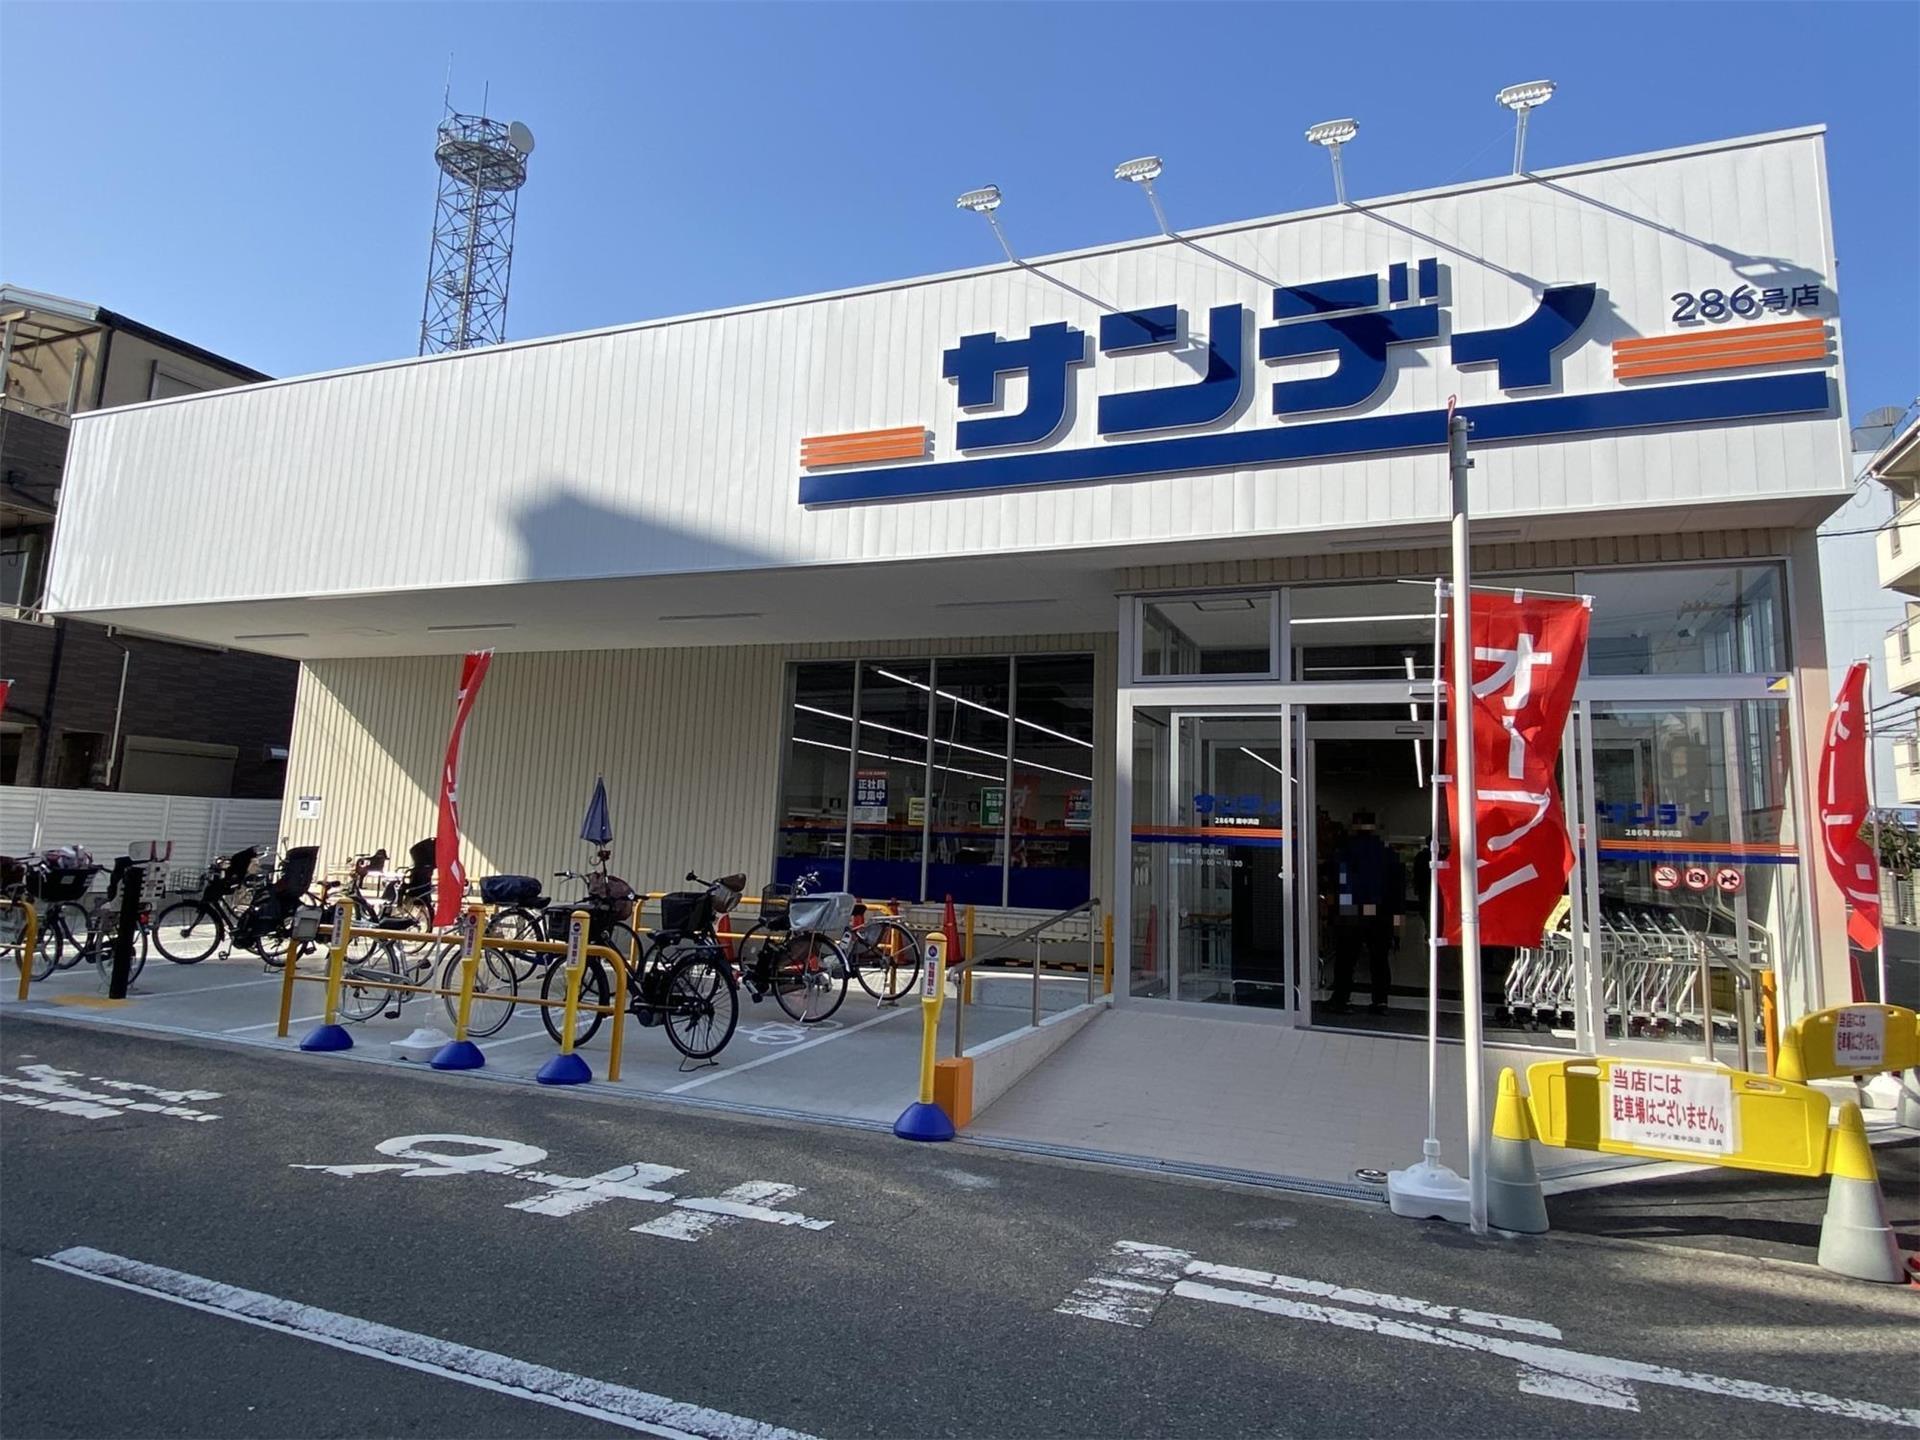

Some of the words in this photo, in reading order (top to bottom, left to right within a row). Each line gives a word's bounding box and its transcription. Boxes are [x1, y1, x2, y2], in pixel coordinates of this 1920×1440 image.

[1670, 283, 1820, 322] 286号店
[943, 256, 1597, 450] サンディ
[1614, 1068, 1682, 1095] 当店には
[1613, 1094, 1724, 1134] 駐車場はございません。
